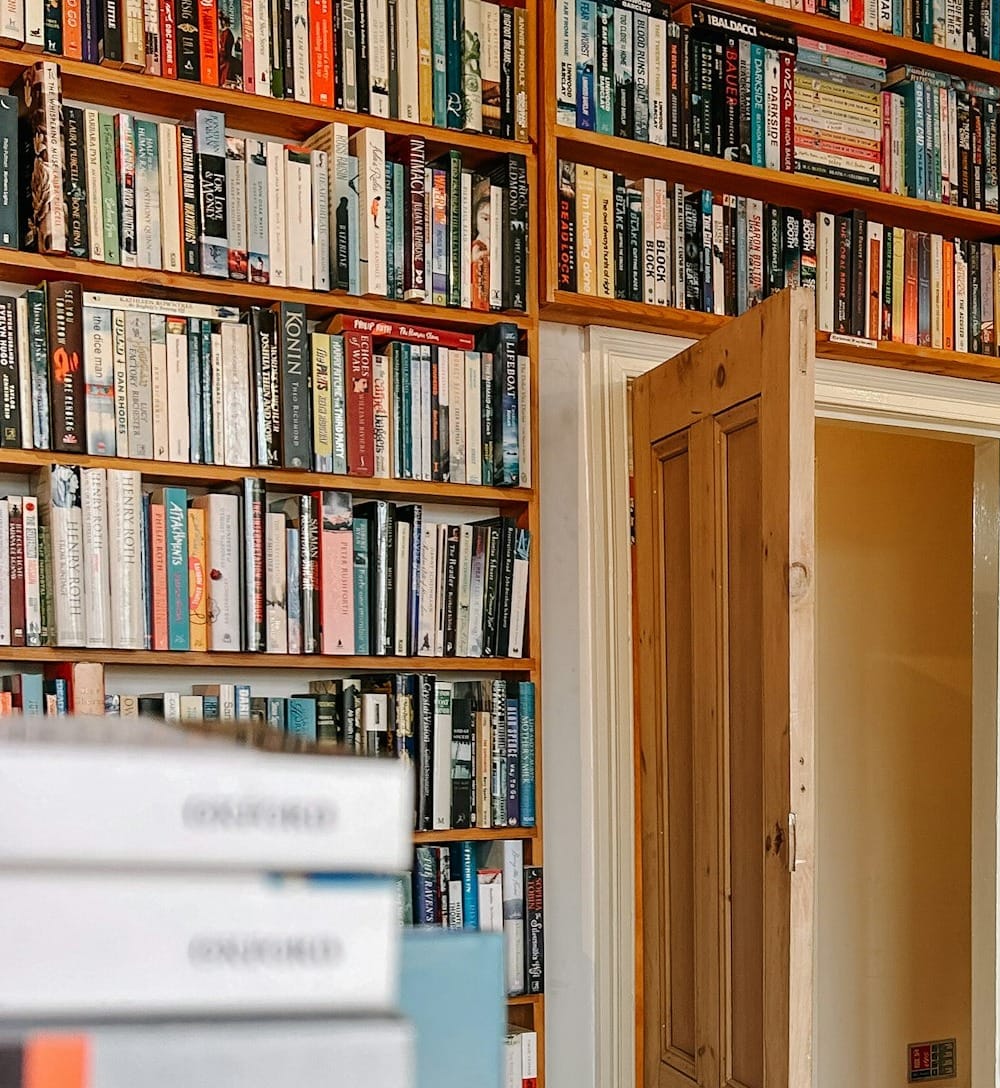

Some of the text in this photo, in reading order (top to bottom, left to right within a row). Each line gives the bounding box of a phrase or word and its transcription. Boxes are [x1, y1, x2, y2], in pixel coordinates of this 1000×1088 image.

[502, 13, 512, 63] BIGFOOT DREAMS
[518, 16, 526, 86] ANNIE PROULX
[711, 16, 757, 37] BALDACCI
[637, 19, 646, 100] BLOOD RUNS COLD
[726, 50, 738, 106] BAUER
[754, 58, 763, 110] DARKSIDE
[783, 67, 793, 111] SNAP
[48, 82, 59, 169] THE WHISPERING MUSE
[183, 132, 196, 243] JONATHAN RABAN WAXWINGS
[205, 170, 214, 179] &
[213, 173, 225, 221] FOR LOVE
[410, 139, 426, 262] INTIMACY JULIAN RATHBONE
[509, 160, 519, 216] REDMOND
[517, 167, 527, 210] PATRICK
[560, 200, 570, 285] DEADLOCK
[646, 239, 656, 279] BLOCK
[752, 214, 761, 289] SHARON BOLTON
[56, 297, 66, 346] TOMORROW
[64, 289, 75, 323] SEE YOU
[93, 316, 103, 378] the dice man
[349, 336, 362, 372] of WAR
[359, 335, 370, 377] ECHOES
[506, 341, 516, 399] LIFEBOAT
[285, 310, 304, 447] KONIN THEO RICHMOND
[123, 476, 135, 566] HENRY ROTH
[169, 500, 186, 566] ATTACHMENTS
